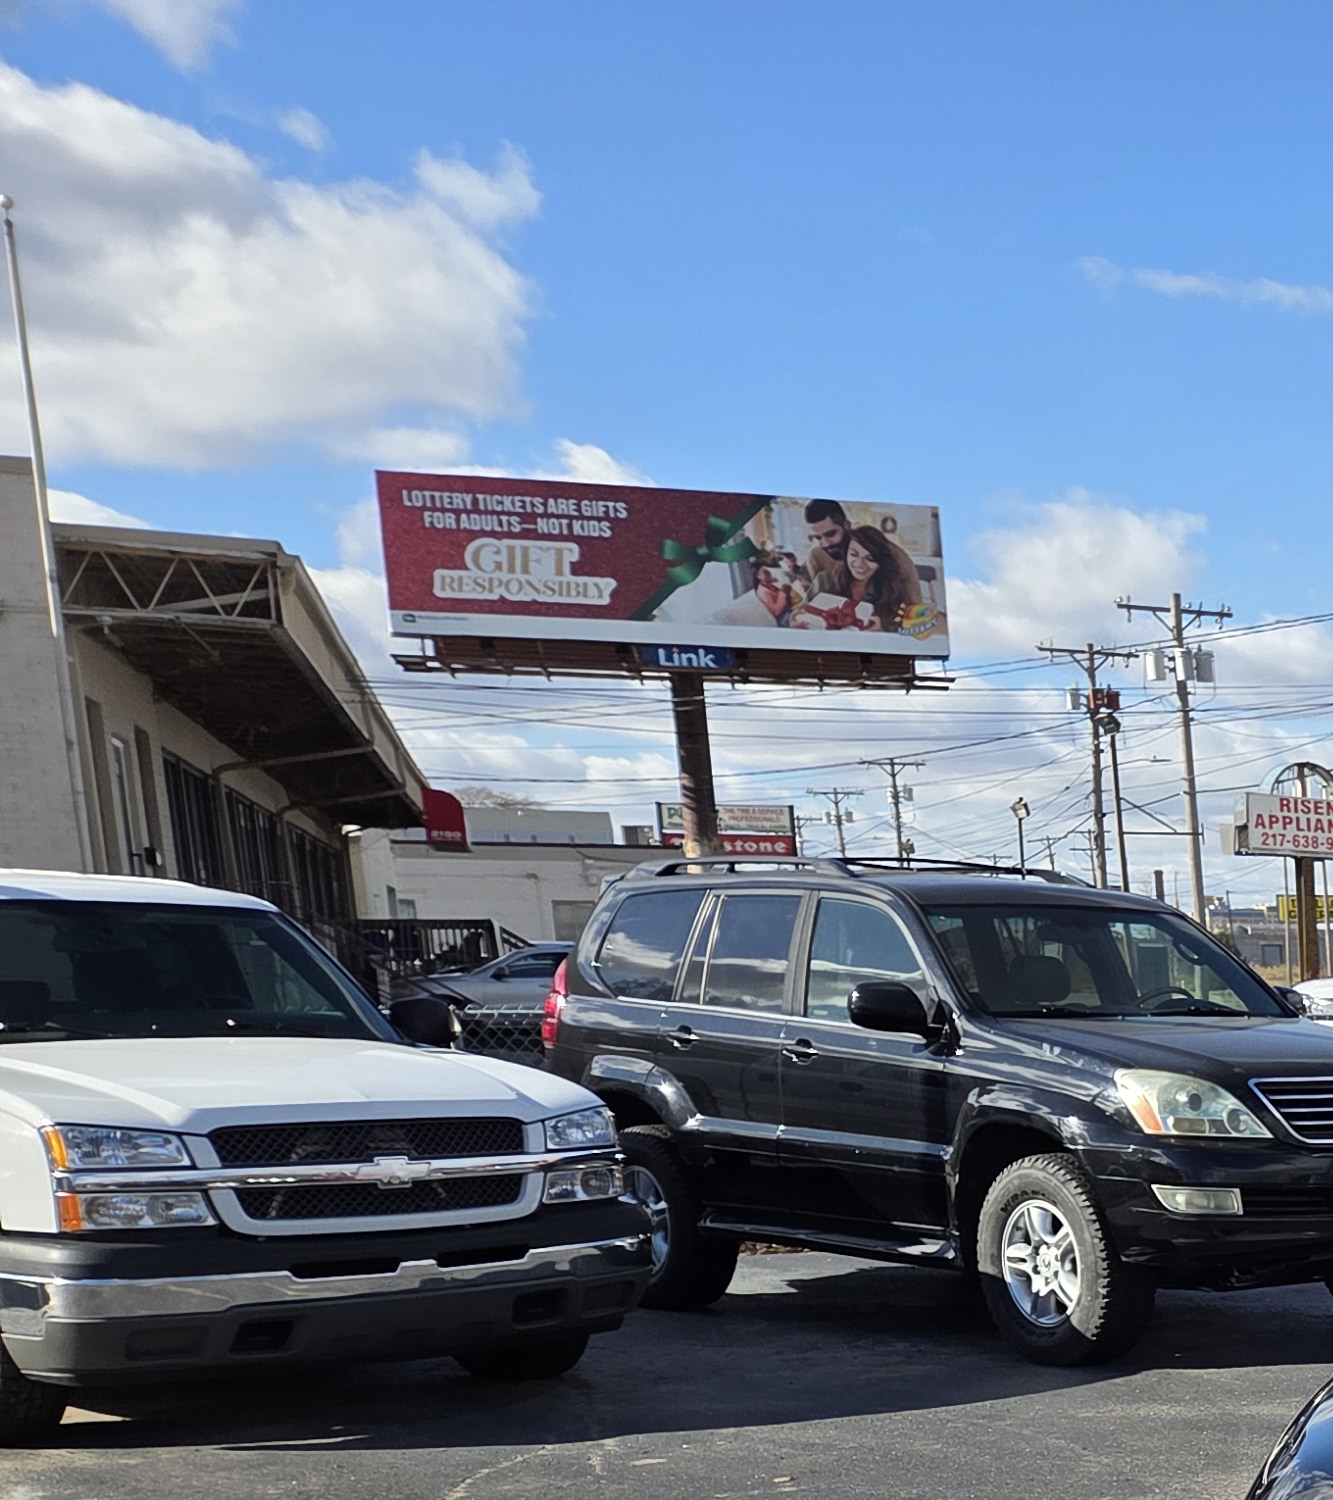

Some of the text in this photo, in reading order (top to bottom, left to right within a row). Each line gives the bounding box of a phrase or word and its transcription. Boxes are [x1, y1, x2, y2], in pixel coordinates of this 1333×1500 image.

[402, 489, 629, 519] LOTTERY TICKETS ARE GIFTS
[423, 511, 457, 529] FOR
[572, 519, 613, 538] KIDS
[471, 542, 574, 577] GIFT
[439, 574, 612, 600] RESPONSIBLY
[657, 647, 720, 669] Link
